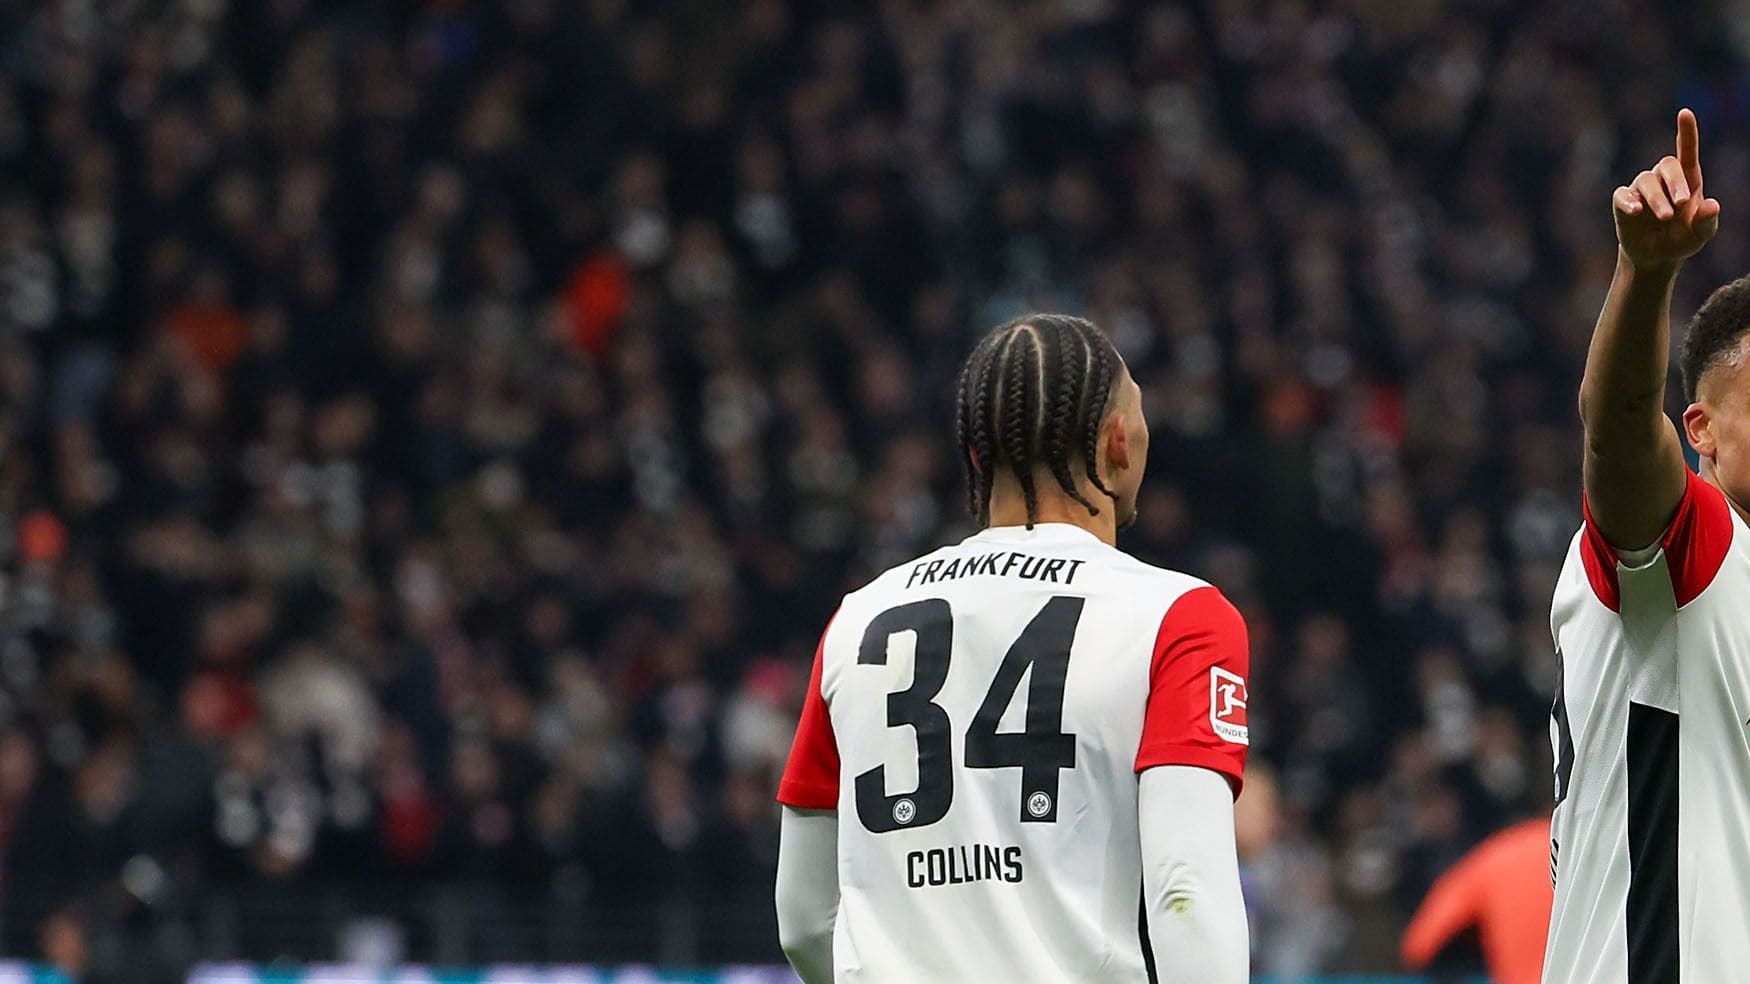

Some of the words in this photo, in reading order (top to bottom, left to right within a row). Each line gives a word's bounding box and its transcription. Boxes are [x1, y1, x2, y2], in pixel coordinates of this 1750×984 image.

[905, 552, 1086, 589] FRANKFURT
[854, 595, 1086, 834] 34
[907, 844, 1023, 888] COLLINS
